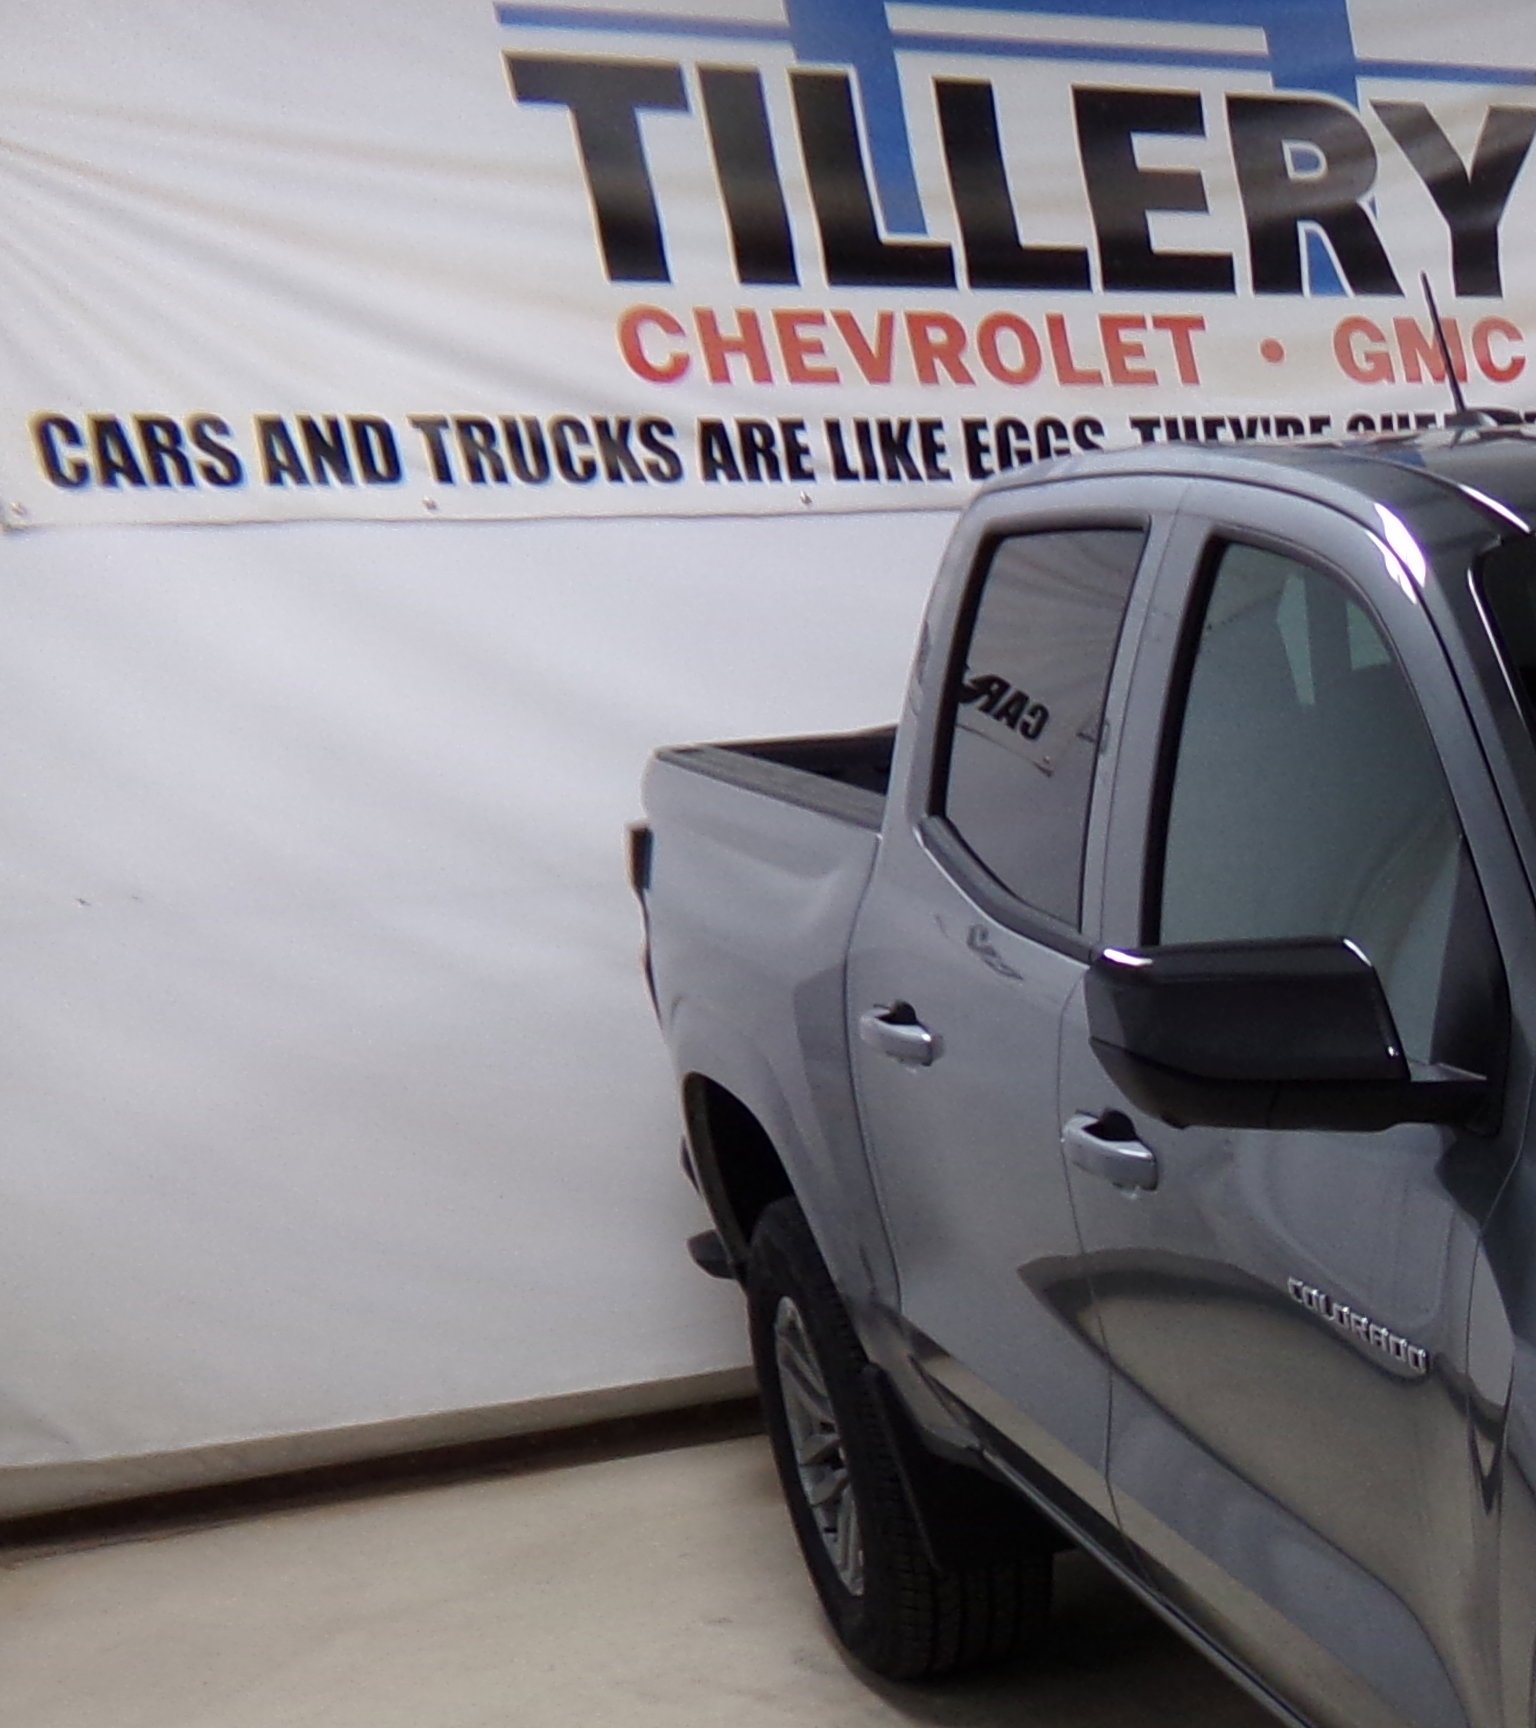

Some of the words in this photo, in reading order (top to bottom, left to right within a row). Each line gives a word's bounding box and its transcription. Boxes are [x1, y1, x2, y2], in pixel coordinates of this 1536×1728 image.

[617, 302, 1207, 388] CHEVROLET
[1332, 314, 1528, 385] GMC
[29, 413, 244, 490] CARS
[253, 413, 402, 488] AND
[407, 415, 682, 484] TRUCKS
[699, 417, 816, 483] ARE
[826, 418, 952, 482] LIKE
[1287, 1275, 1429, 1376] COLORADO
